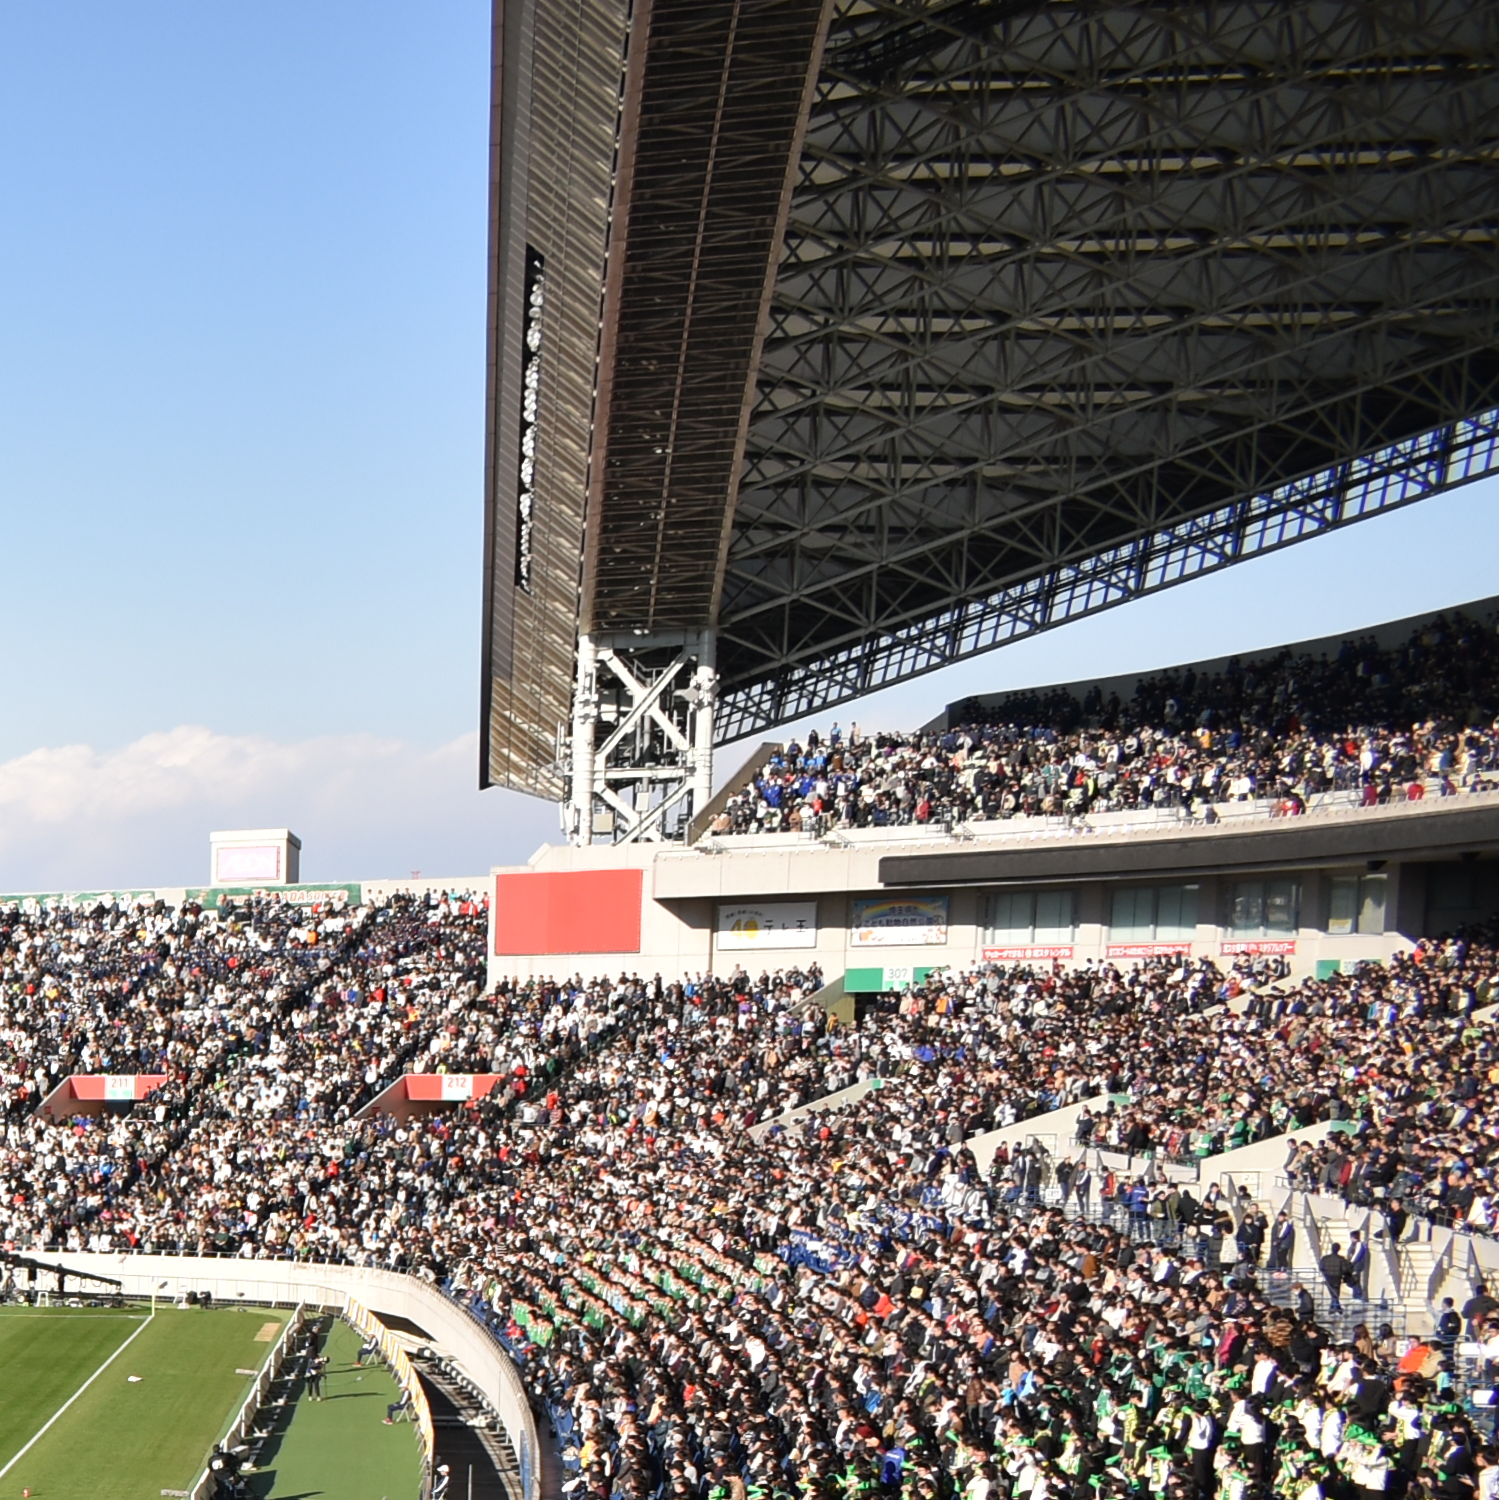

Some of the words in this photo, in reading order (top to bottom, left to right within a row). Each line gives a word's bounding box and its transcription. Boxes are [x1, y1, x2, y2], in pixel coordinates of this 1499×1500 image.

[888, 969, 908, 979] 307
[111, 1078, 129, 1088] 211
[447, 1077, 467, 1088] 212
